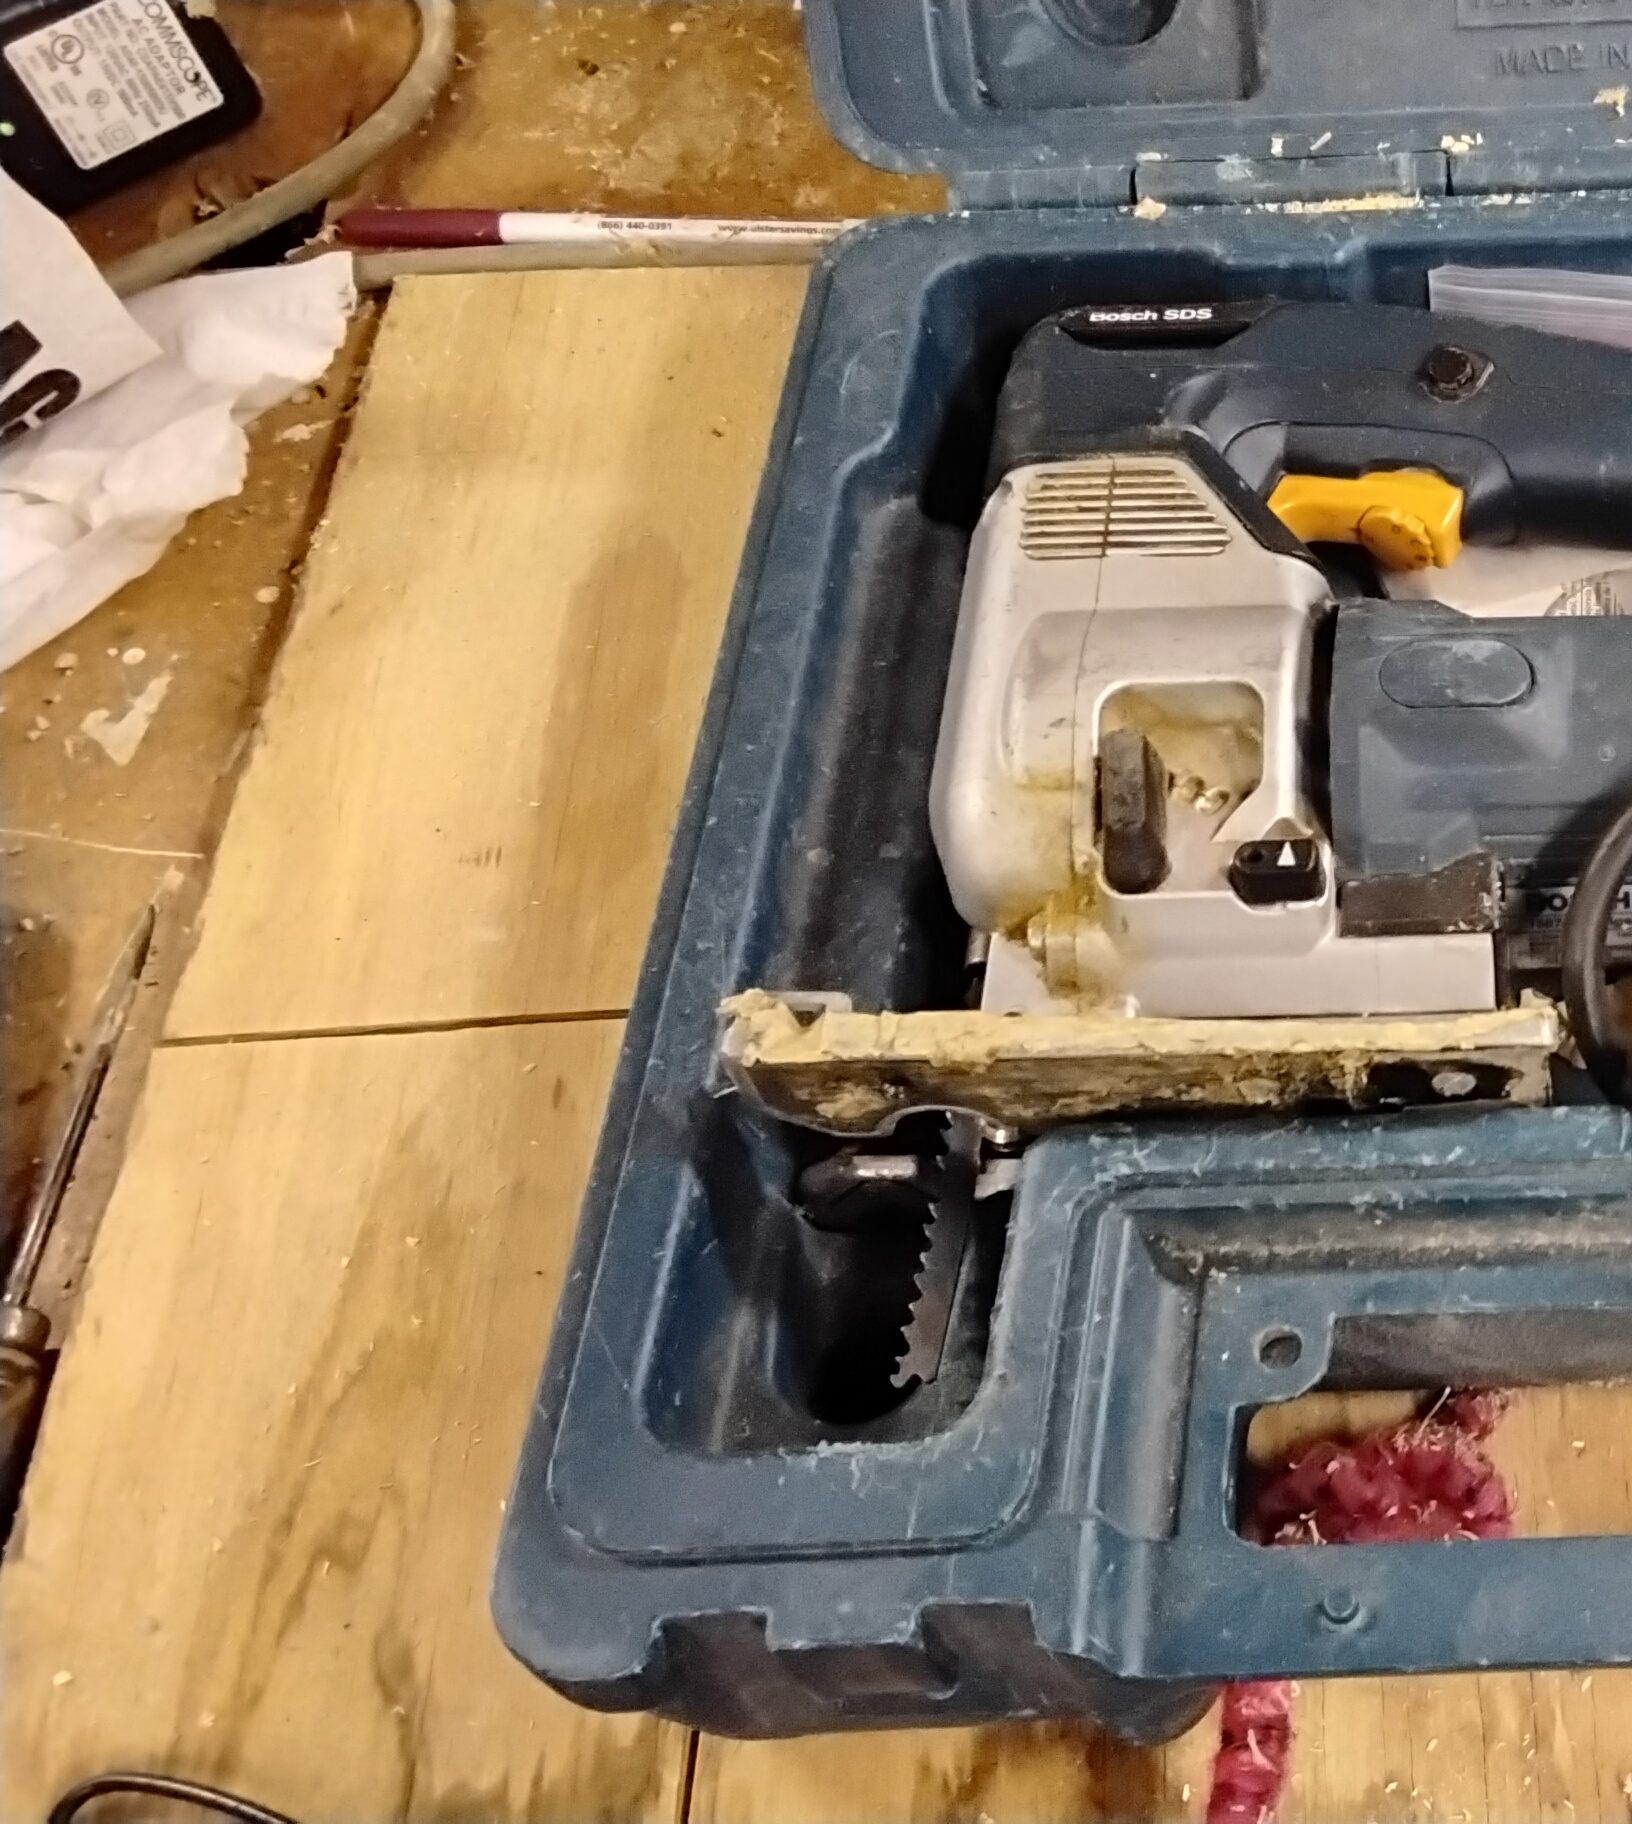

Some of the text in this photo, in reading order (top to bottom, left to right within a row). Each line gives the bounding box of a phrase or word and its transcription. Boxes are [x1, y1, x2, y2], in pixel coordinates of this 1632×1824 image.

[132, 18, 149, 34] AC
[145, 38, 186, 95] ADAPTOR
[138, 0, 213, 101] OMMSCOPE
[1495, 43, 1588, 75] MADE
[1601, 43, 1631, 70] IN
[1089, 308, 1213, 322] Bosch SDS
